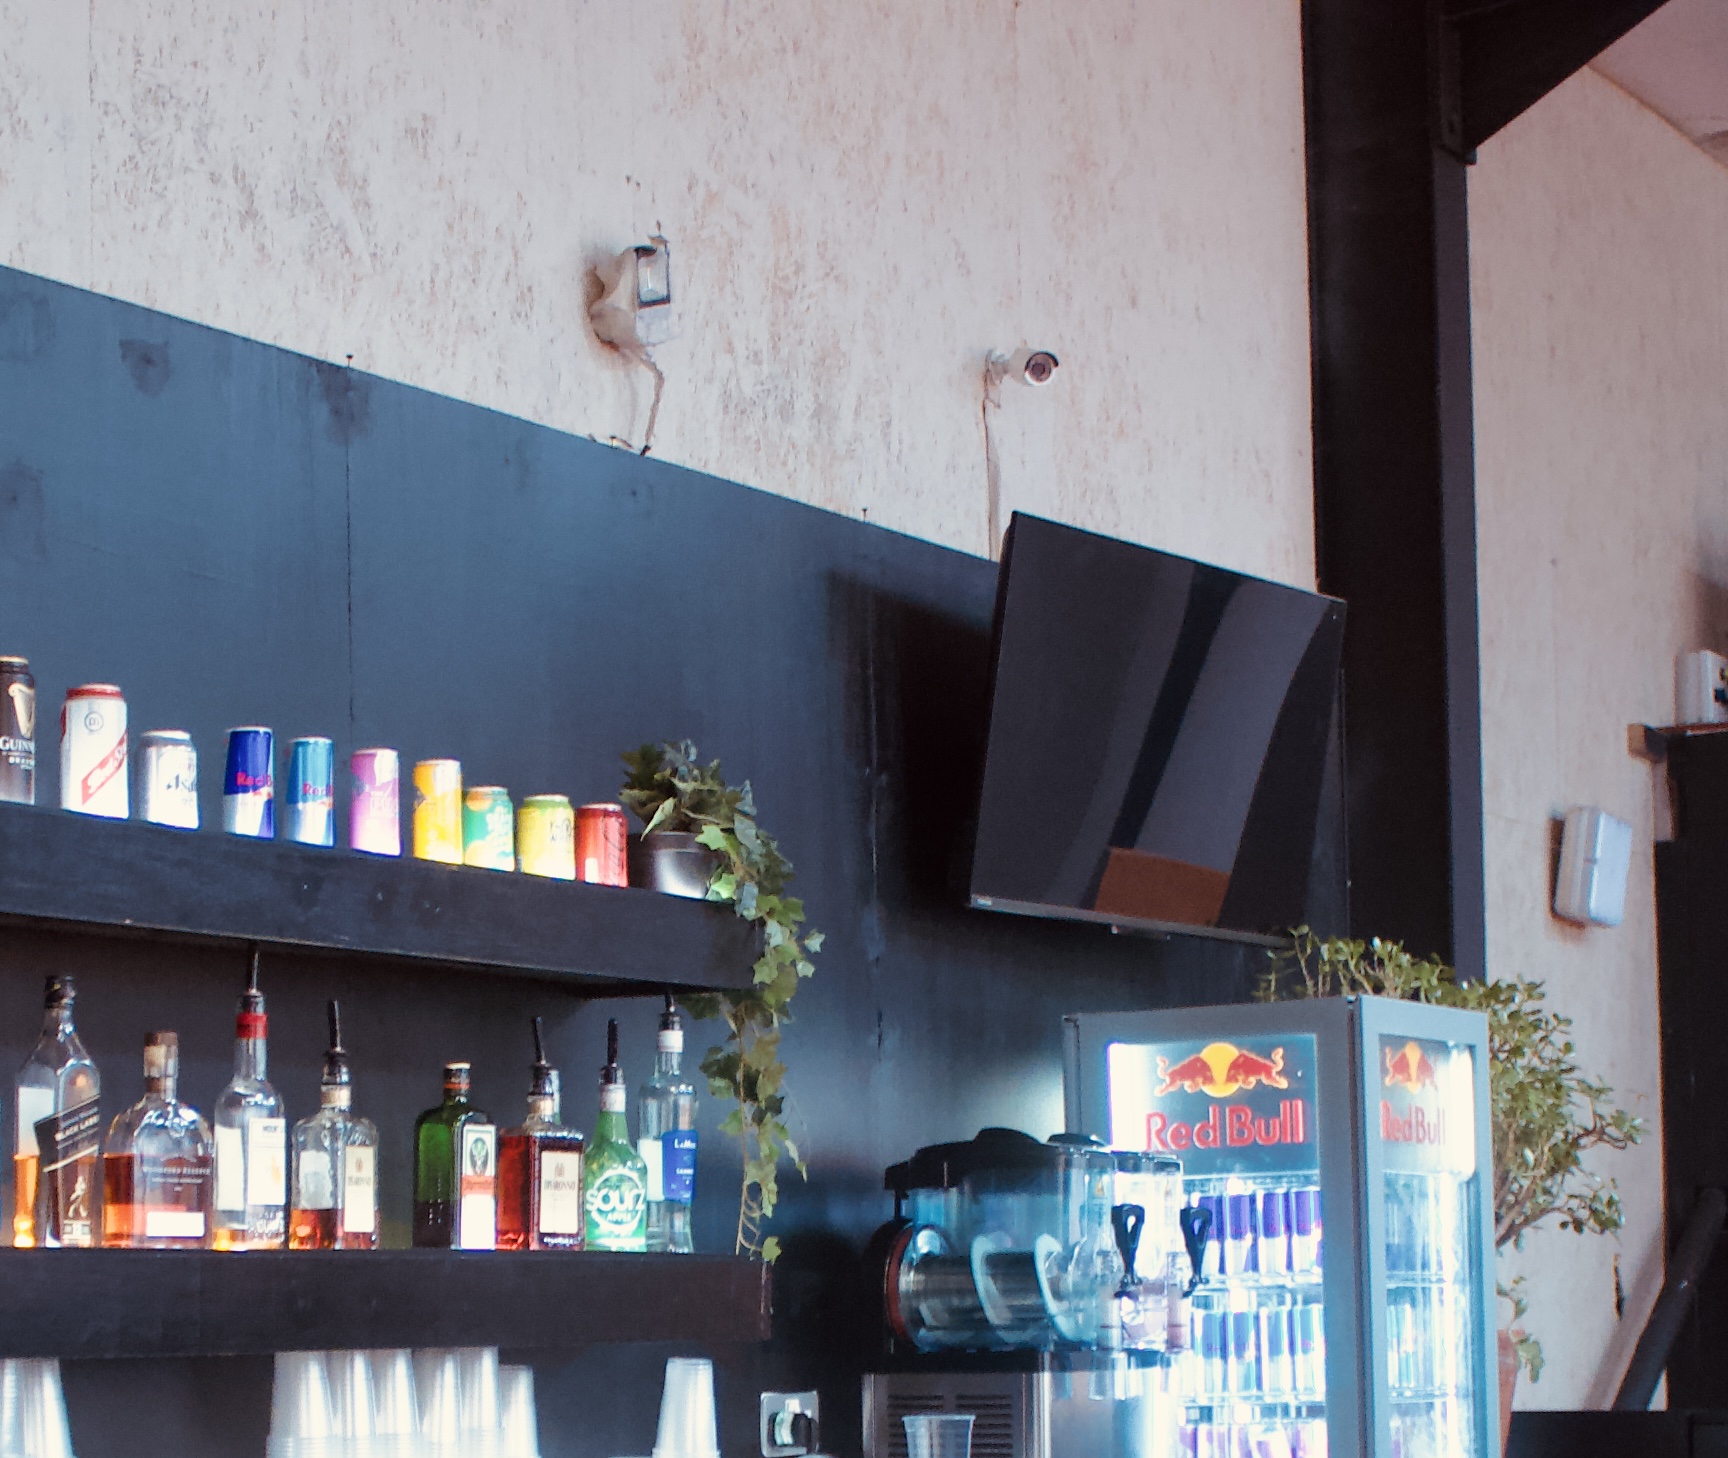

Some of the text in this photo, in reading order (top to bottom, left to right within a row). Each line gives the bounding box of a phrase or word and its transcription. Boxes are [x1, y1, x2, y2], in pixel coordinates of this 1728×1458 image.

[1144, 1099, 1305, 1152] Red Bull
[1380, 1099, 1445, 1146] Red Bull
